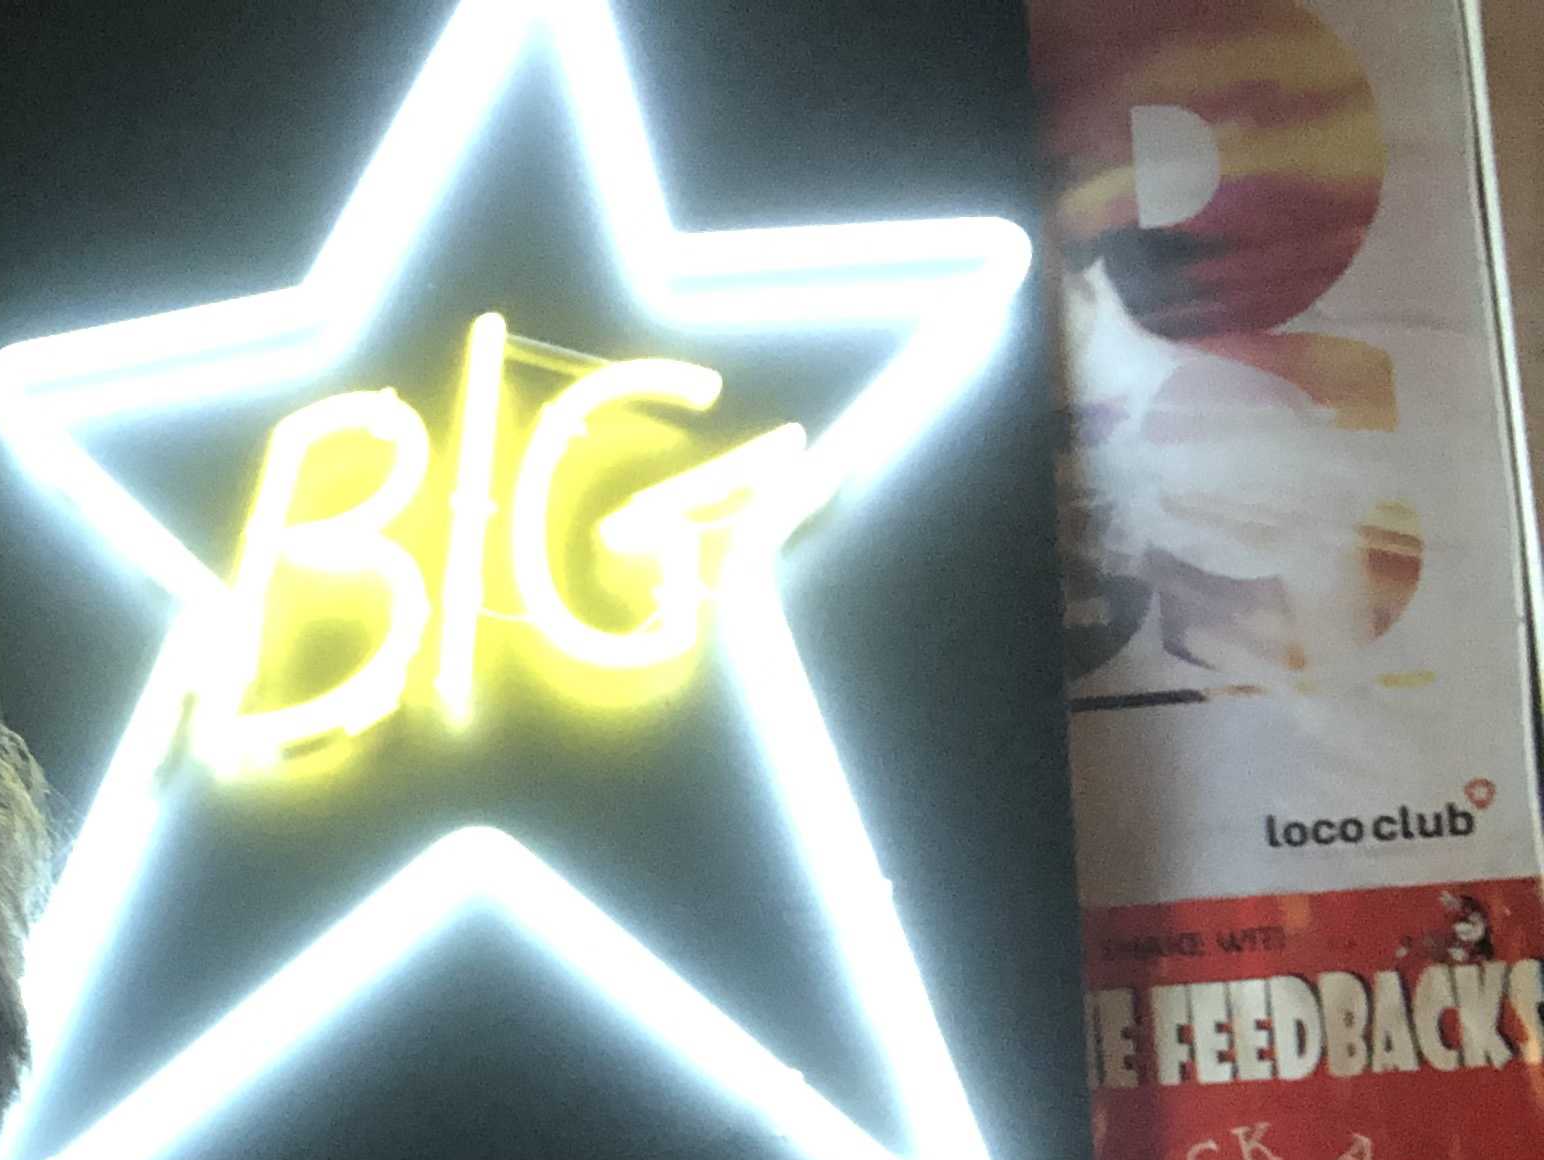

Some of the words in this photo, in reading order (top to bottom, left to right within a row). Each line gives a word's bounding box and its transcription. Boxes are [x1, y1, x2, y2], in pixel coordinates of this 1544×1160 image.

[191, 310, 808, 782] BIG
[1265, 814, 1364, 847] loco
[1372, 802, 1475, 841] club
